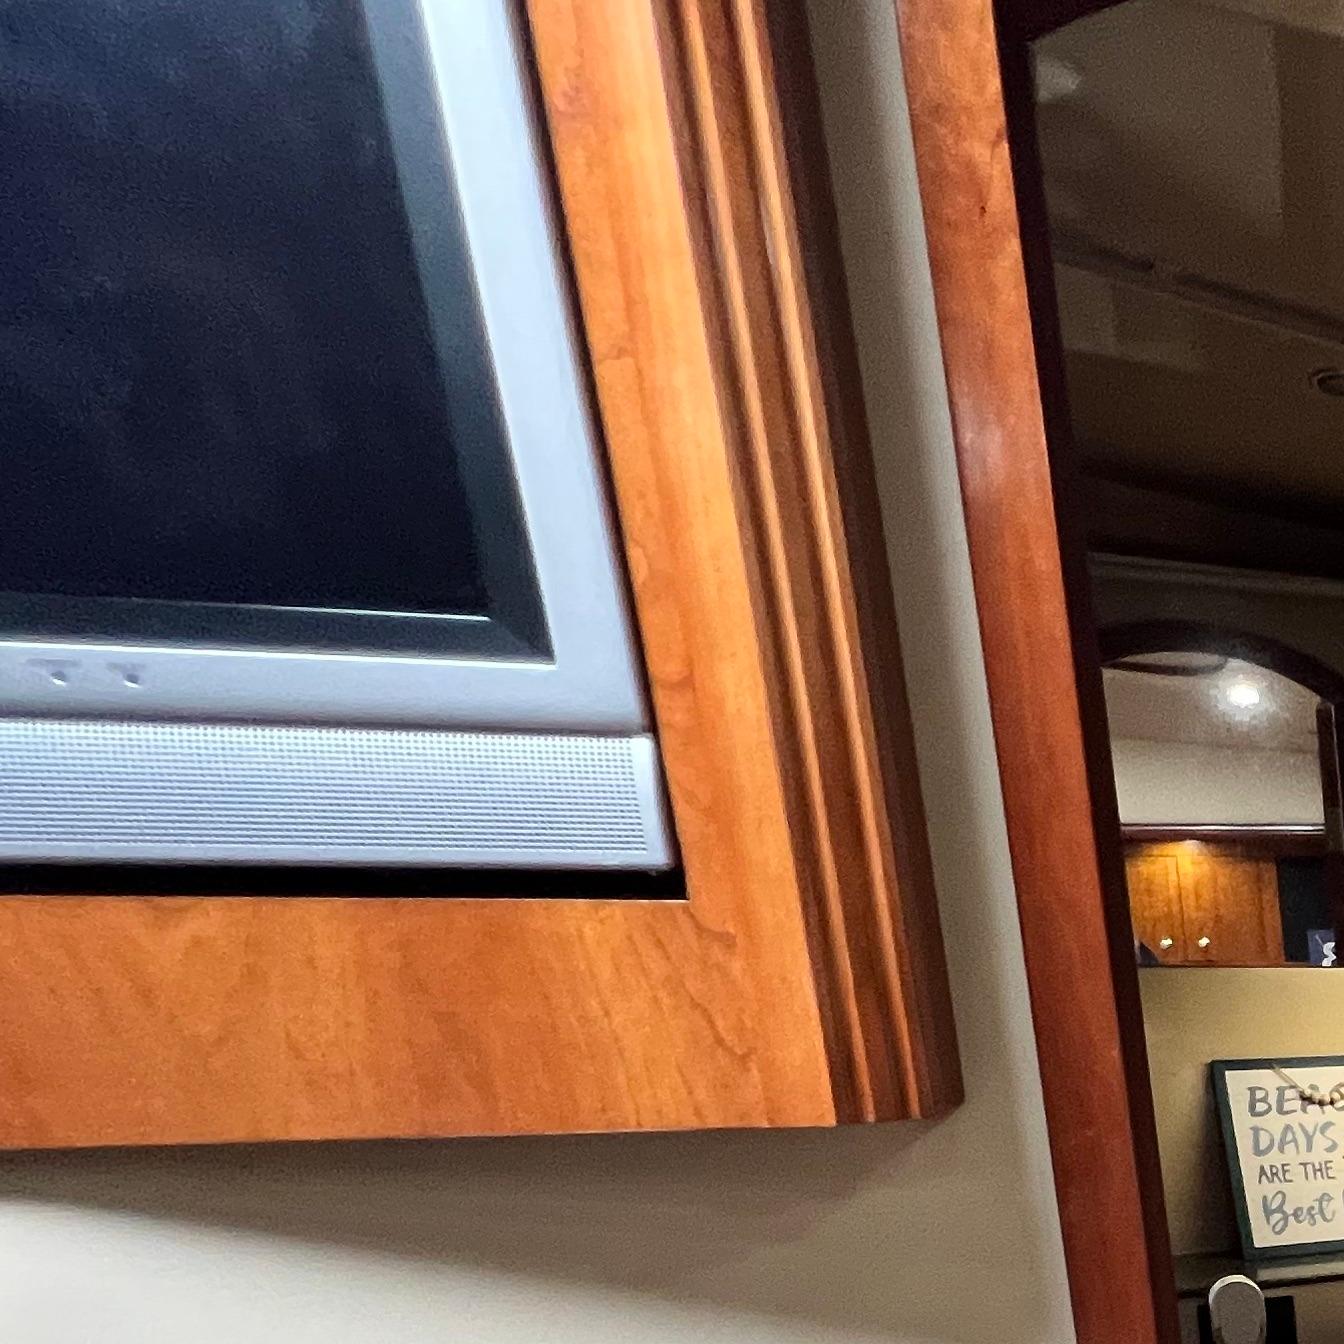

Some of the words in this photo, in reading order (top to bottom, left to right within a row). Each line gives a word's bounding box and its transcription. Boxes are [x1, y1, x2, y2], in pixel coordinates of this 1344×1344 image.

[1249, 1120, 1339, 1157] DAYS
[1257, 1162, 1294, 1185] ARE
[1300, 1160, 1337, 1181] THE
[1261, 1189, 1337, 1236] Best
